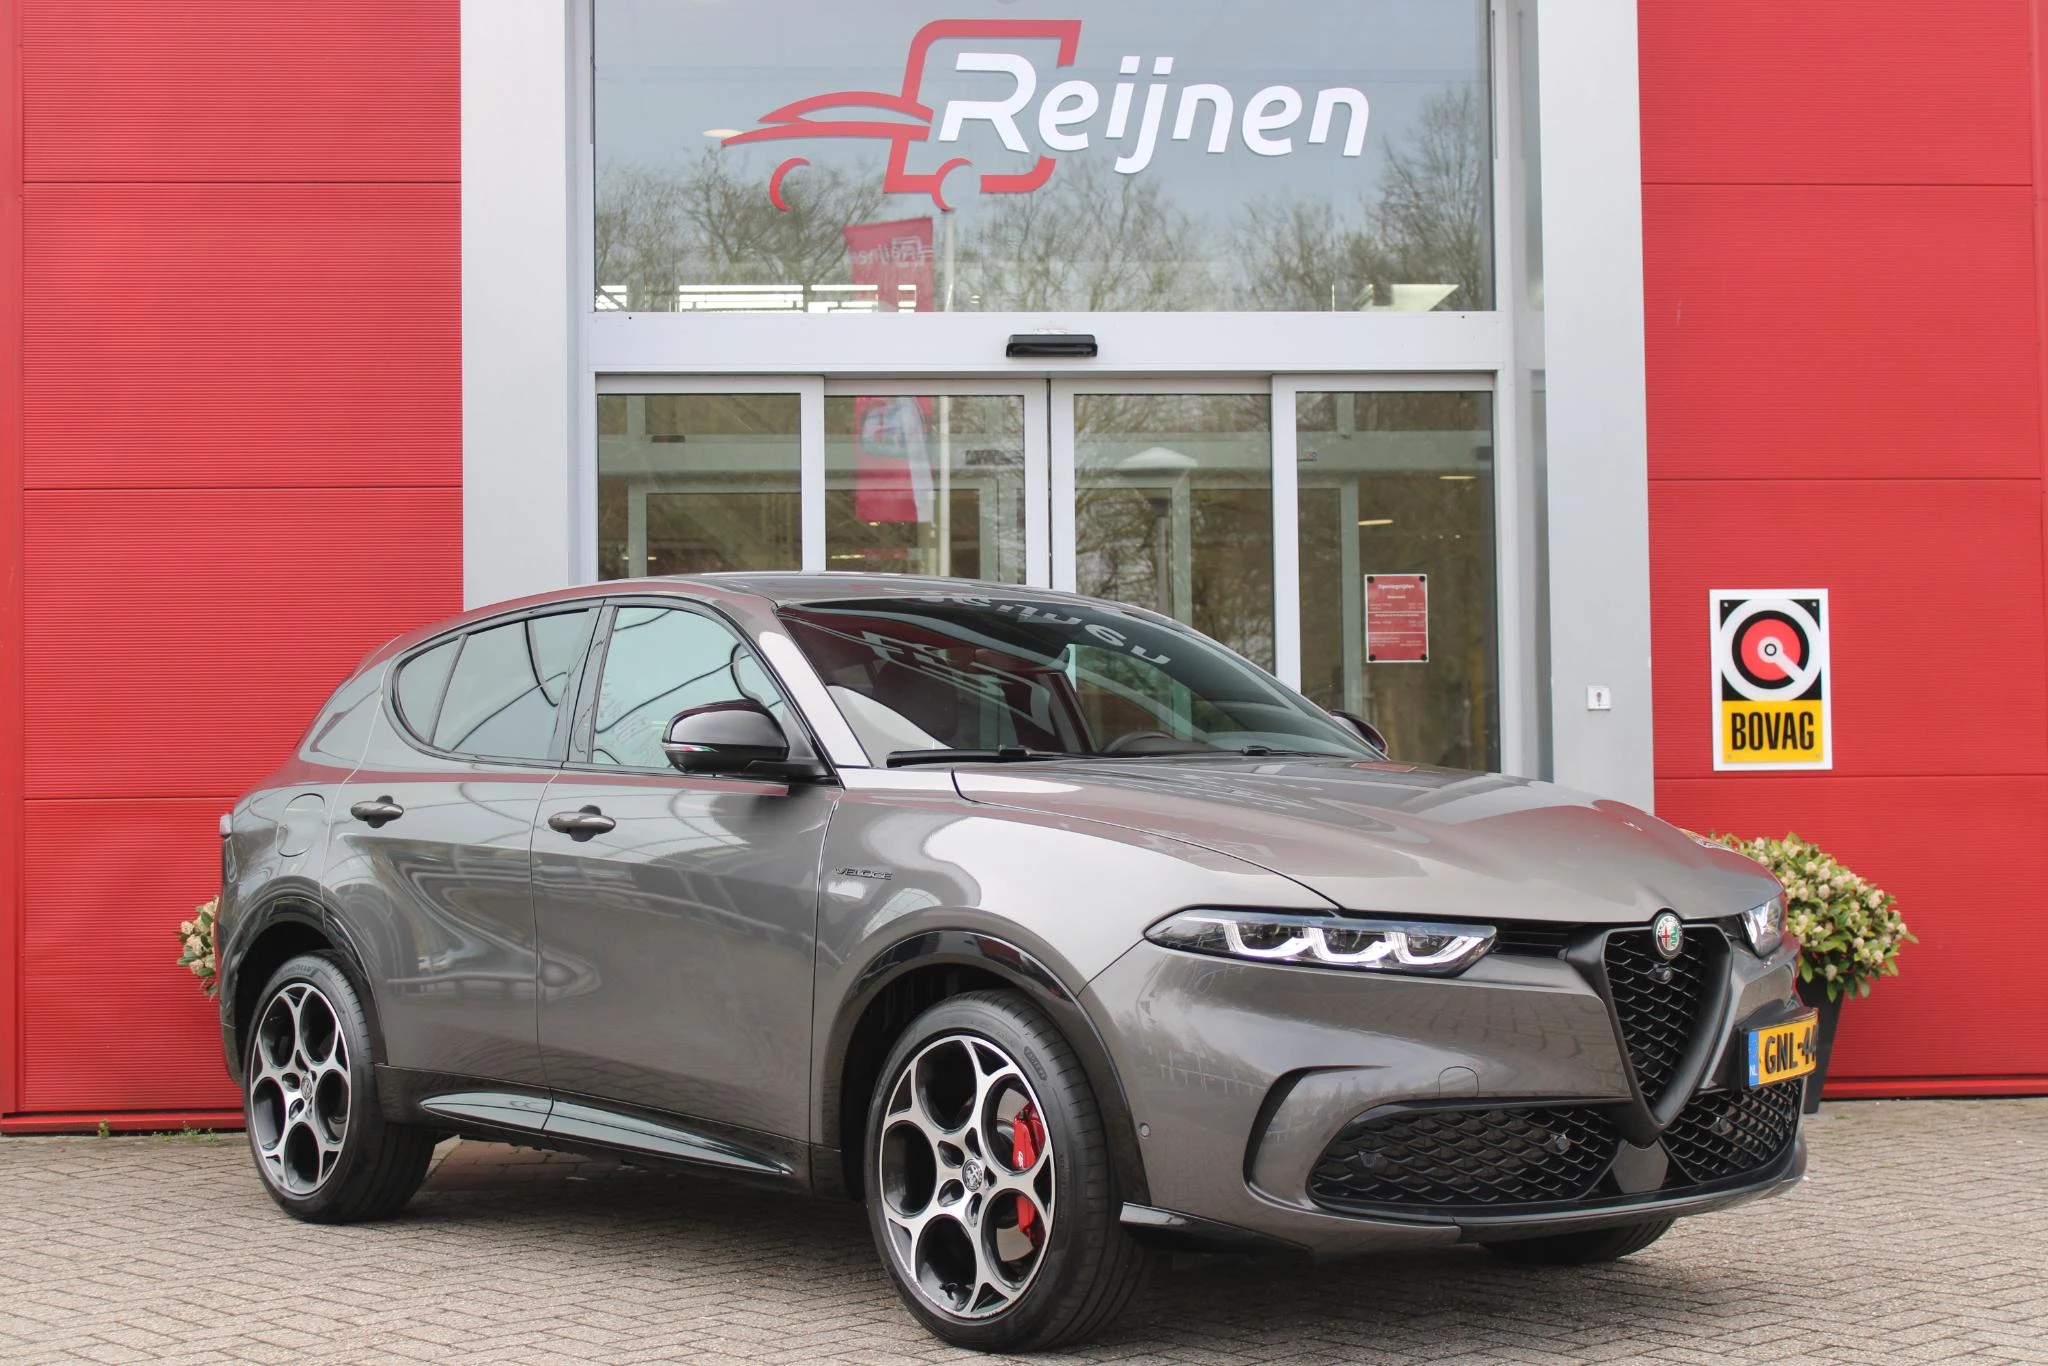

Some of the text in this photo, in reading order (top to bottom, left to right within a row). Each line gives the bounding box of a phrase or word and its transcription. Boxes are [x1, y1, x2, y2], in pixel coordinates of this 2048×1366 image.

[938, 53, 1370, 174] Reijnen
[1731, 711, 1814, 751] BOVAG
[834, 866, 893, 880] VELOCE
